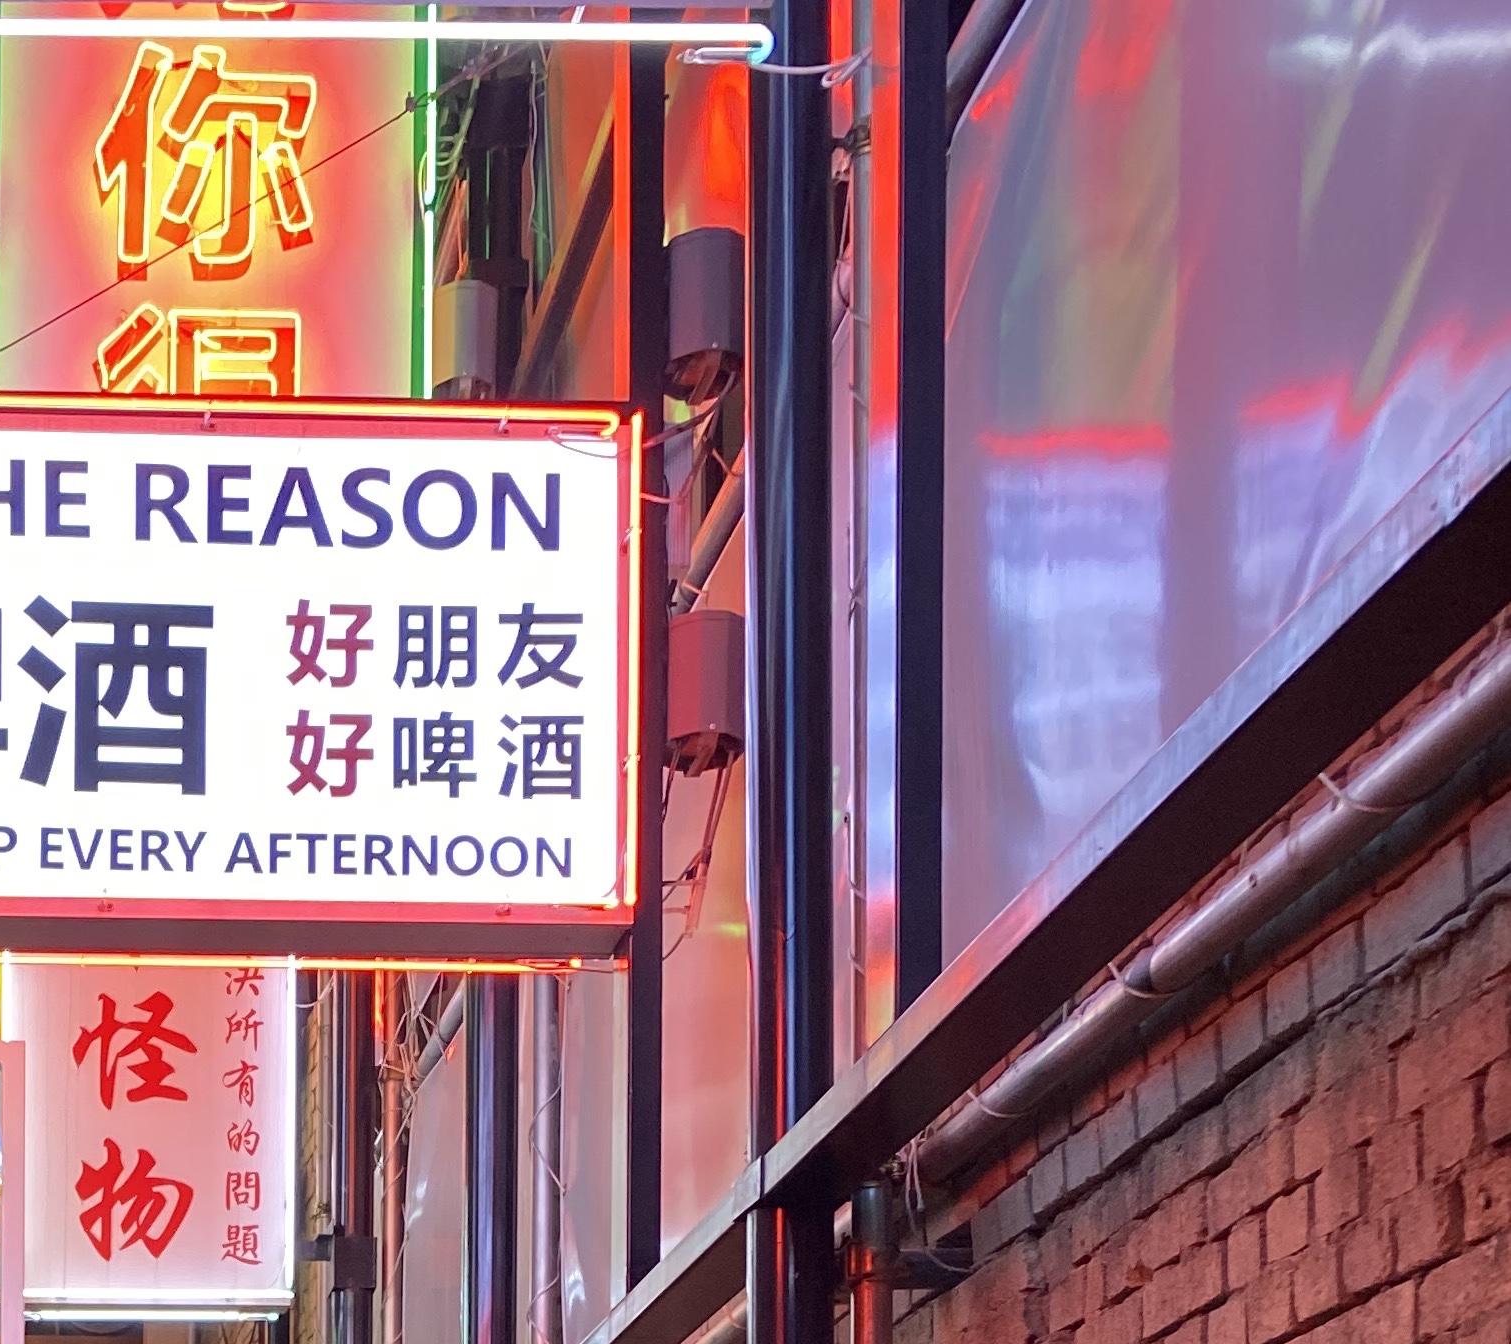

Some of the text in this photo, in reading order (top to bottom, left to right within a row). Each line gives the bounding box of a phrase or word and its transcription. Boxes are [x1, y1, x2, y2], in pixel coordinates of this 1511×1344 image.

[134, 461, 562, 552] REASON
[286, 599, 585, 690] 好朋友
[286, 708, 585, 799] 好啤酒
[40, 827, 208, 872] EVERY
[224, 831, 573, 878] AFTERNOON
[72, 990, 198, 1263] 怪物
